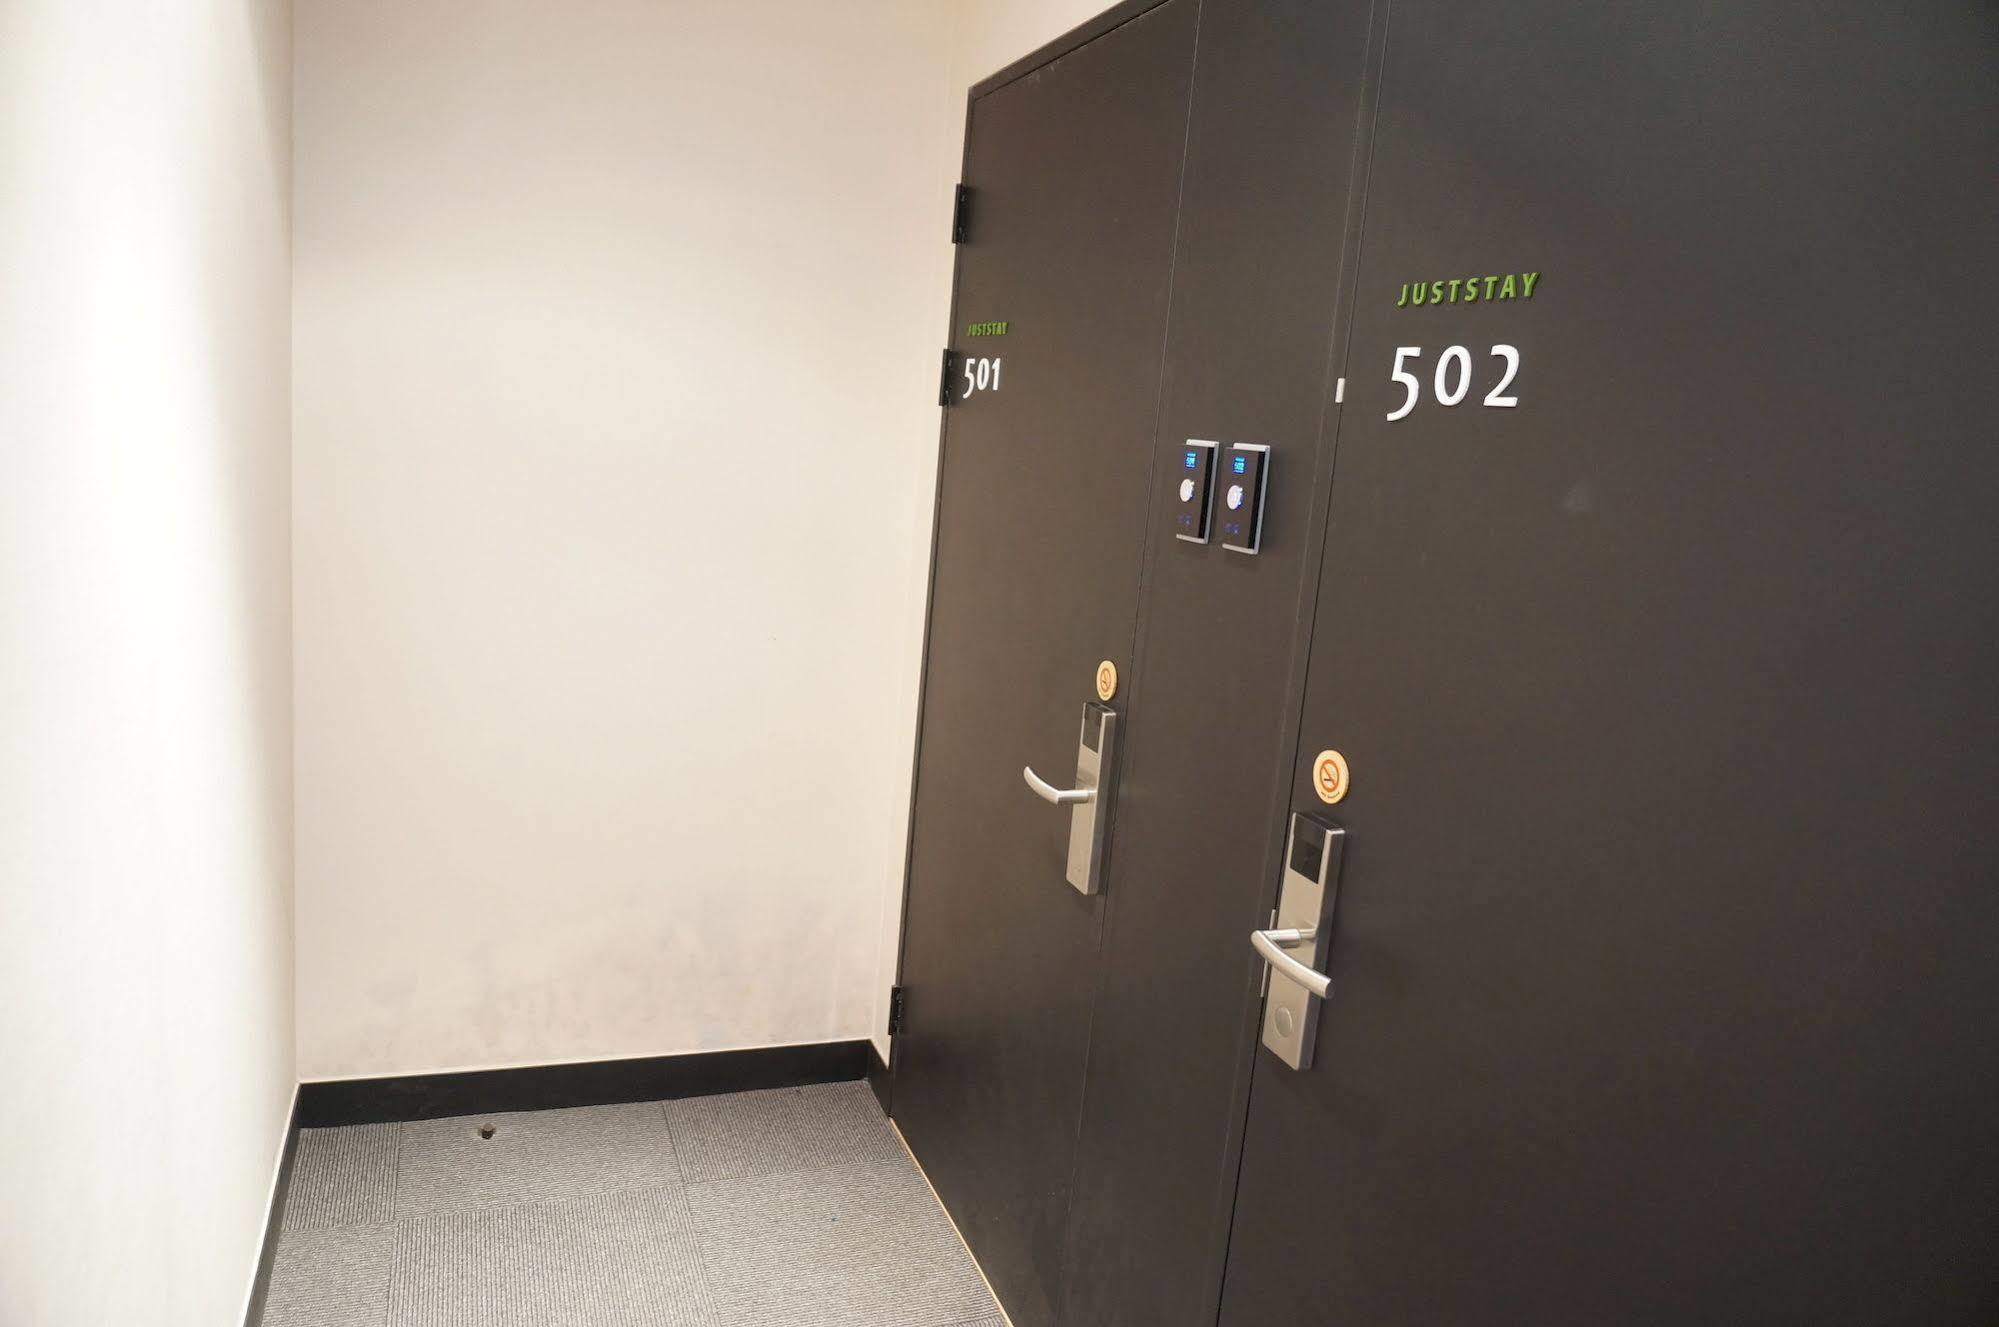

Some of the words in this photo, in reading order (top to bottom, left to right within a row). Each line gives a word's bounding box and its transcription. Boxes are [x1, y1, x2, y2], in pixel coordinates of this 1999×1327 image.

[1397, 272, 1541, 307] JUSTSTAY
[963, 358, 1001, 399] 501
[1386, 344, 1520, 422] 502
